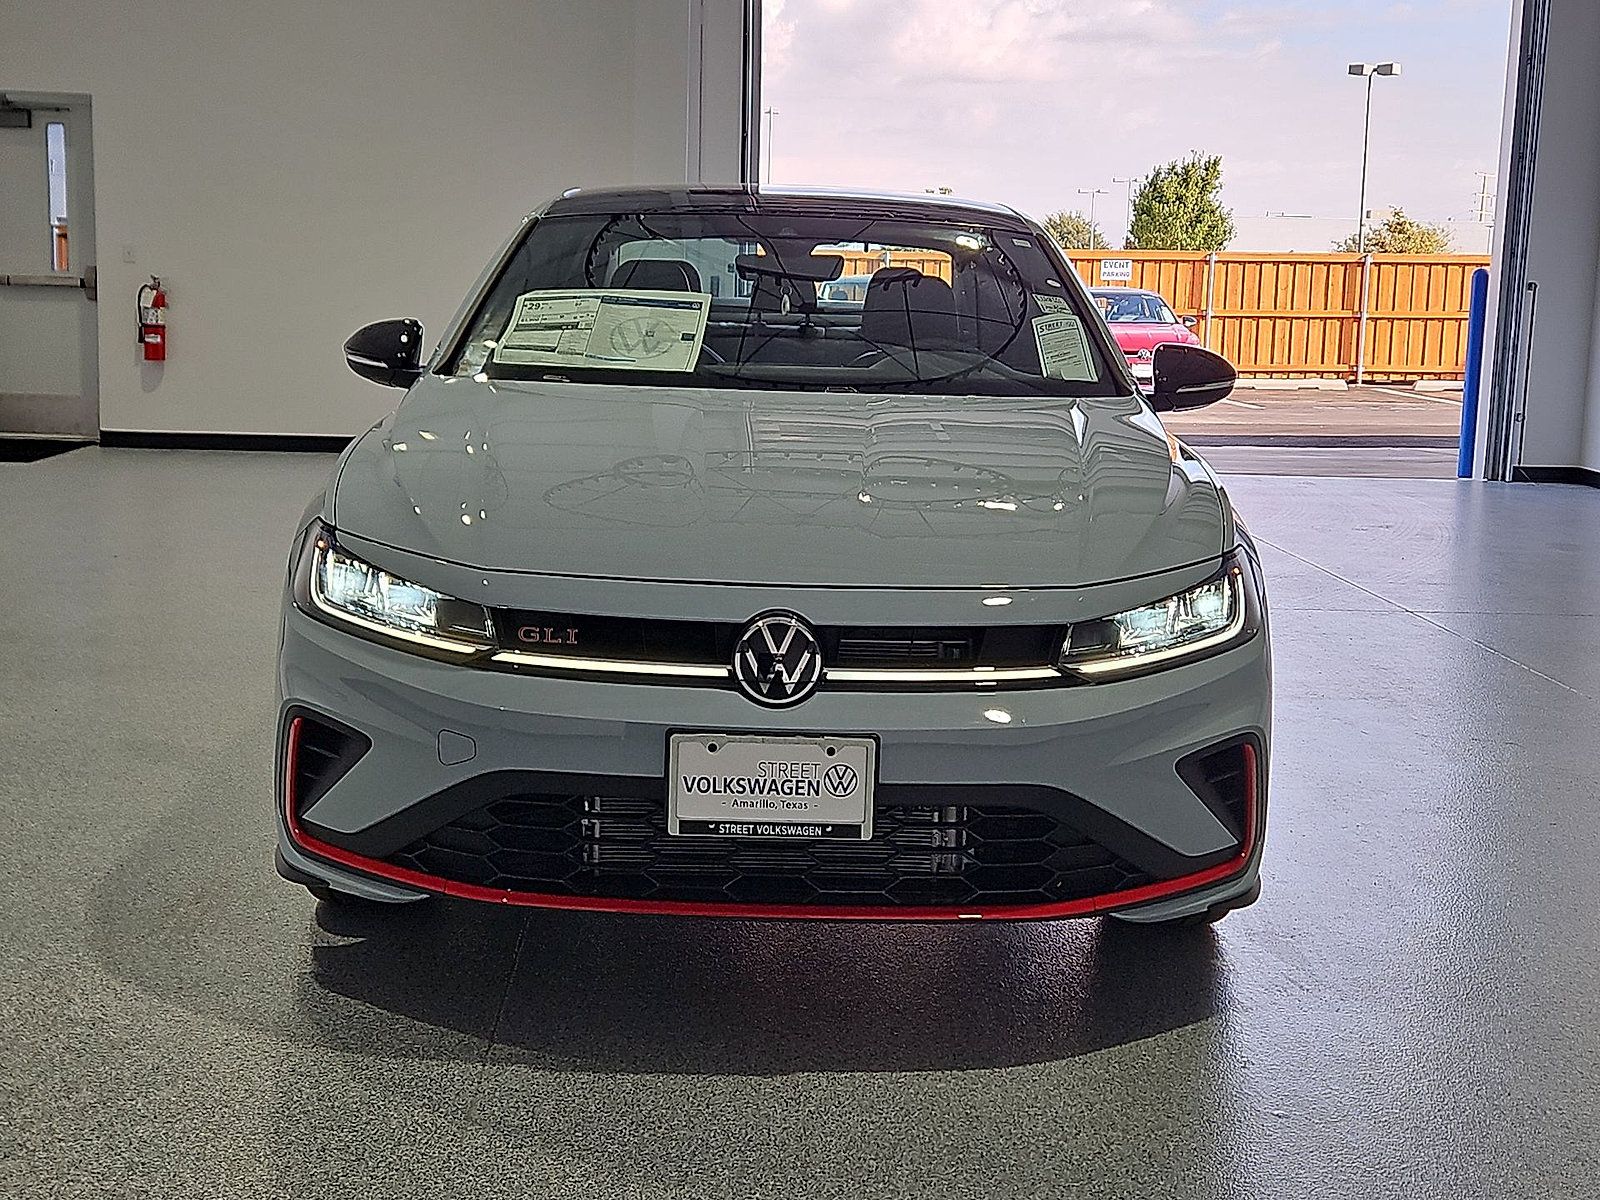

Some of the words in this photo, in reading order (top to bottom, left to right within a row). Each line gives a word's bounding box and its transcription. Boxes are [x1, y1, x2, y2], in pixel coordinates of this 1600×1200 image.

[1103, 261, 1130, 269] EVENT
[527, 303, 541, 311] 29
[517, 626, 578, 644] GLI
[735, 616, 821, 704] VW
[757, 761, 821, 778] STREET
[682, 776, 821, 797] VOLKSWAGEN
[823, 763, 858, 797] VW
[731, 799, 778, 810] Amarillo,
[780, 800, 808, 810] Texas
[719, 824, 754, 834] STREET
[756, 826, 822, 836] VOLKSWAGEN
